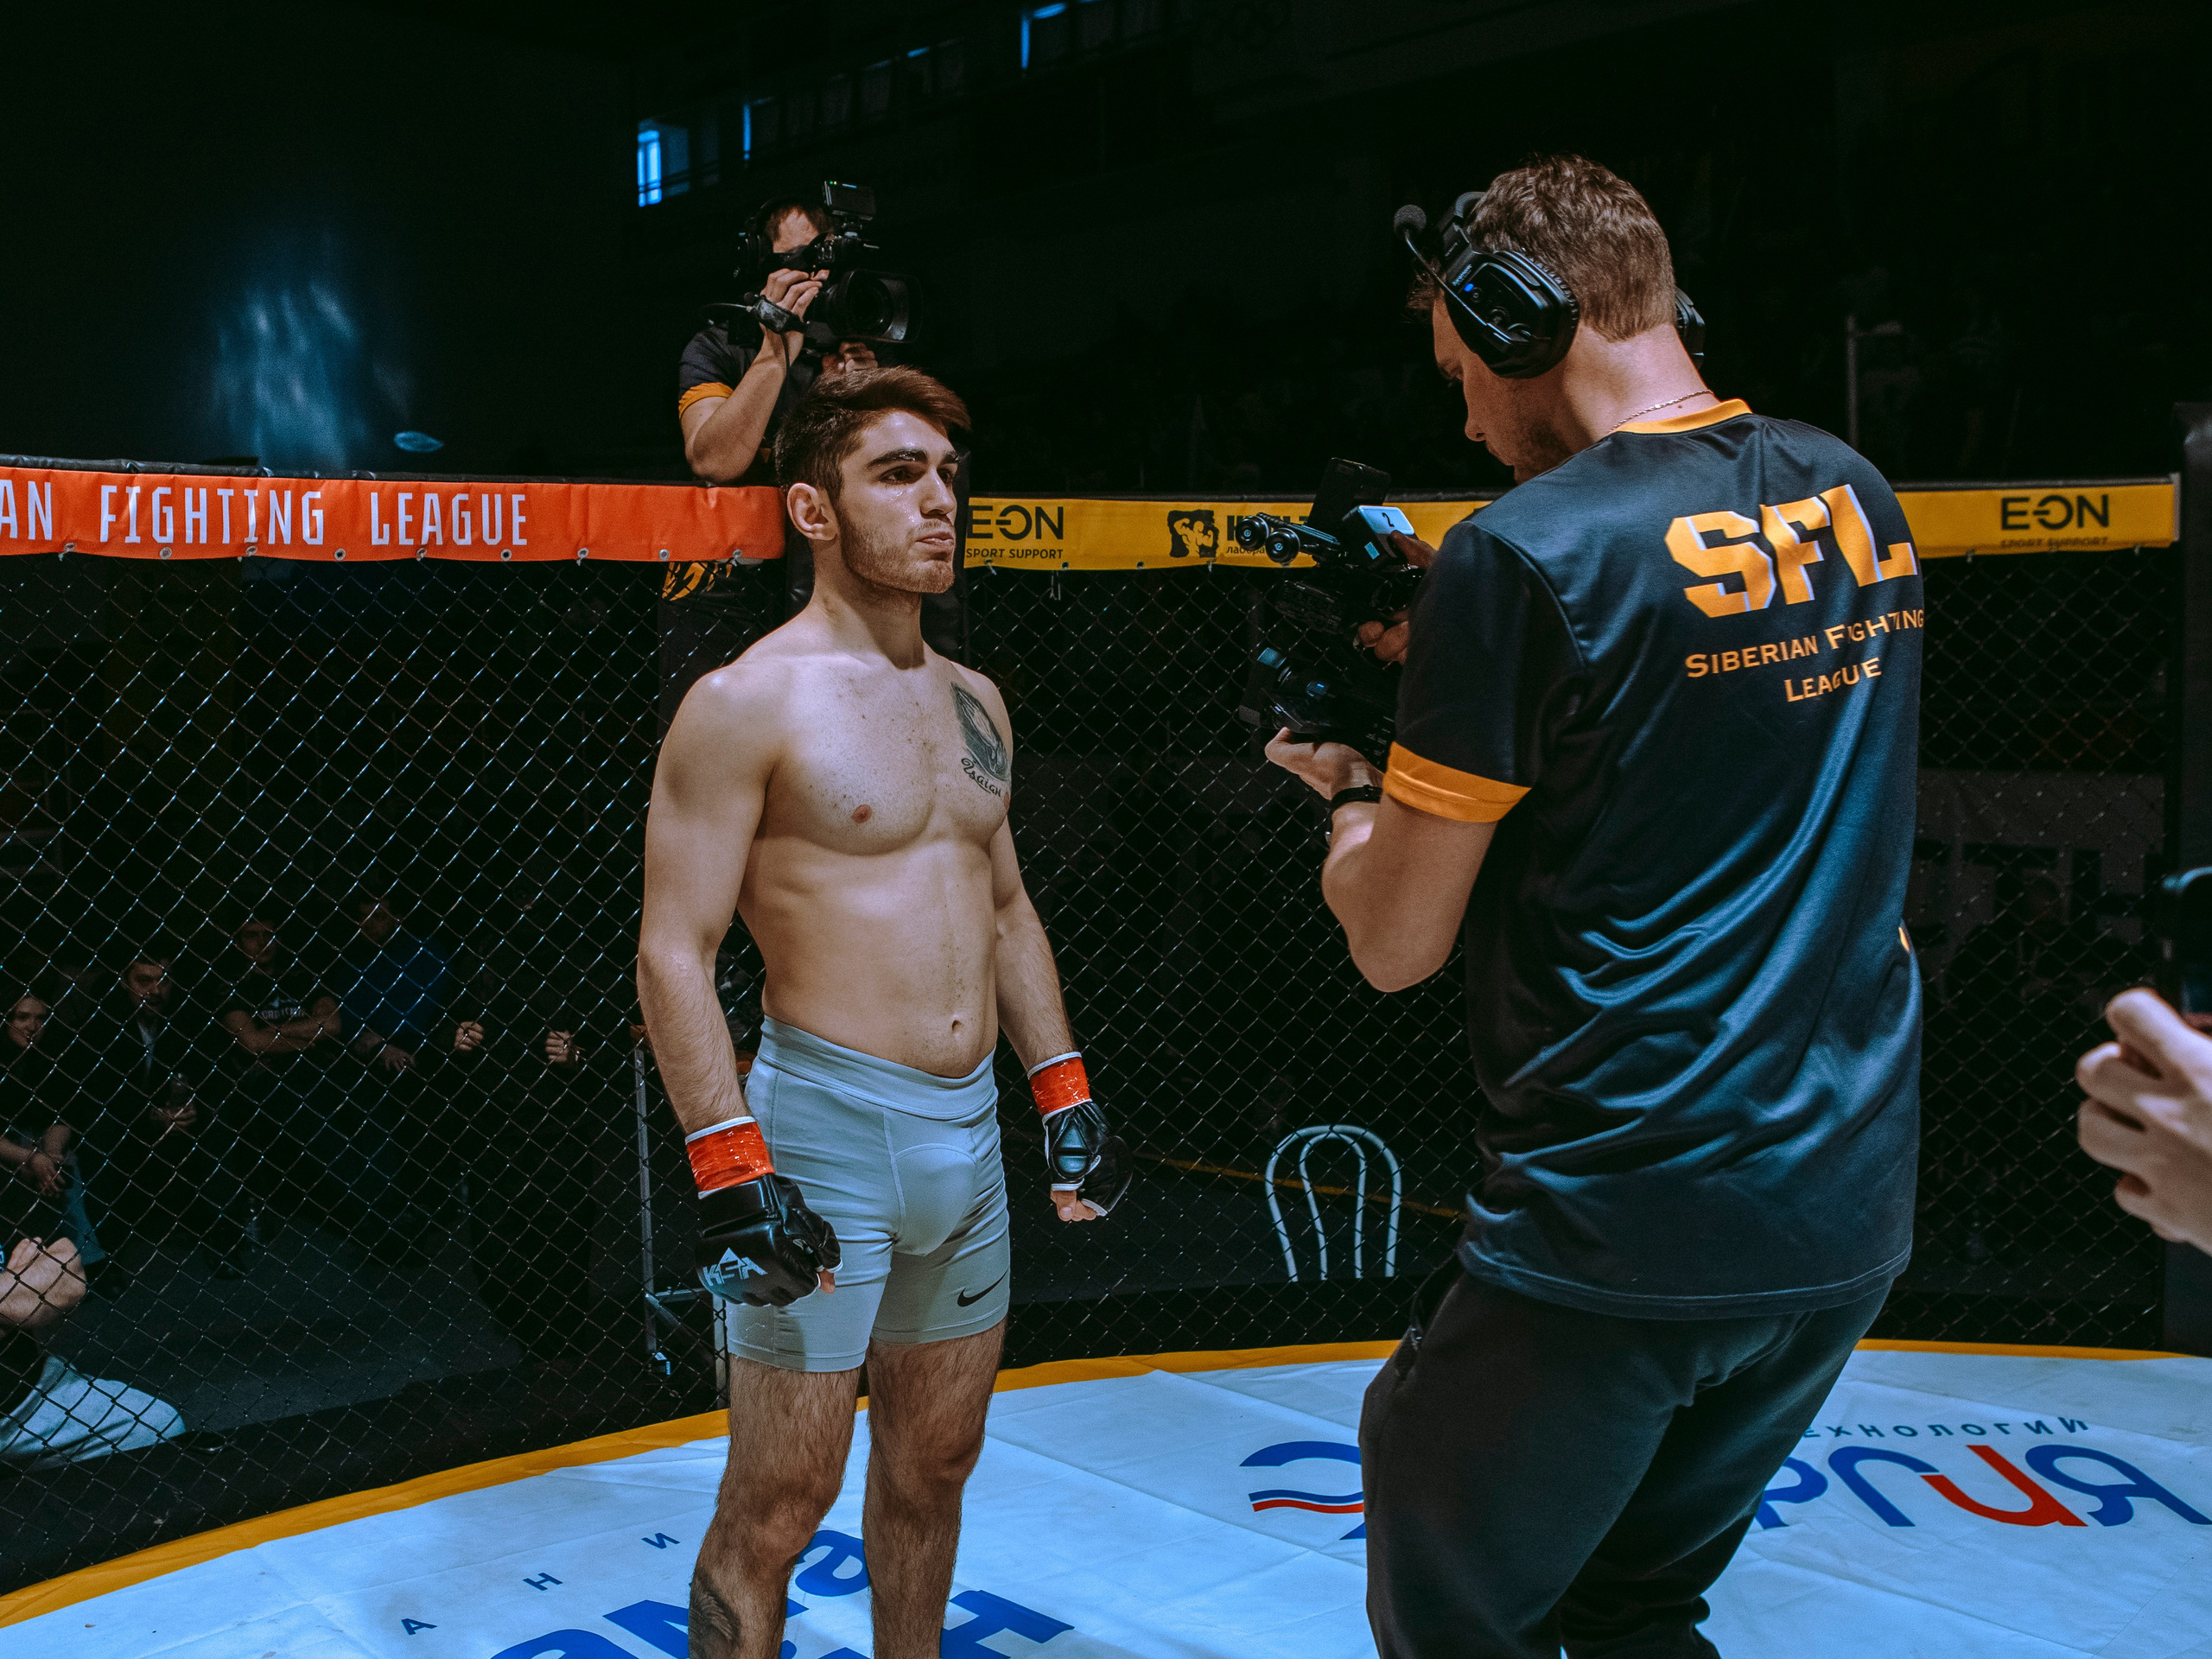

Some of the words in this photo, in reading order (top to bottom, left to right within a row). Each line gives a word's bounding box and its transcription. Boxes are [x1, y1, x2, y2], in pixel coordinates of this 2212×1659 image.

[0, 480, 54, 542] AN
[99, 485, 325, 546] FIGHTING
[370, 492, 529, 548] LEAGUE
[1382, 512, 1395, 528] 2
[965, 548, 1006, 559] SPORT
[1008, 548, 1065, 560] SUPPORT
[1664, 484, 1918, 619] SFL
[1684, 635, 1819, 678] SIBERIAN
[1823, 608, 1925, 650] FIGHTING
[1783, 657, 1883, 702] LEAGUE
